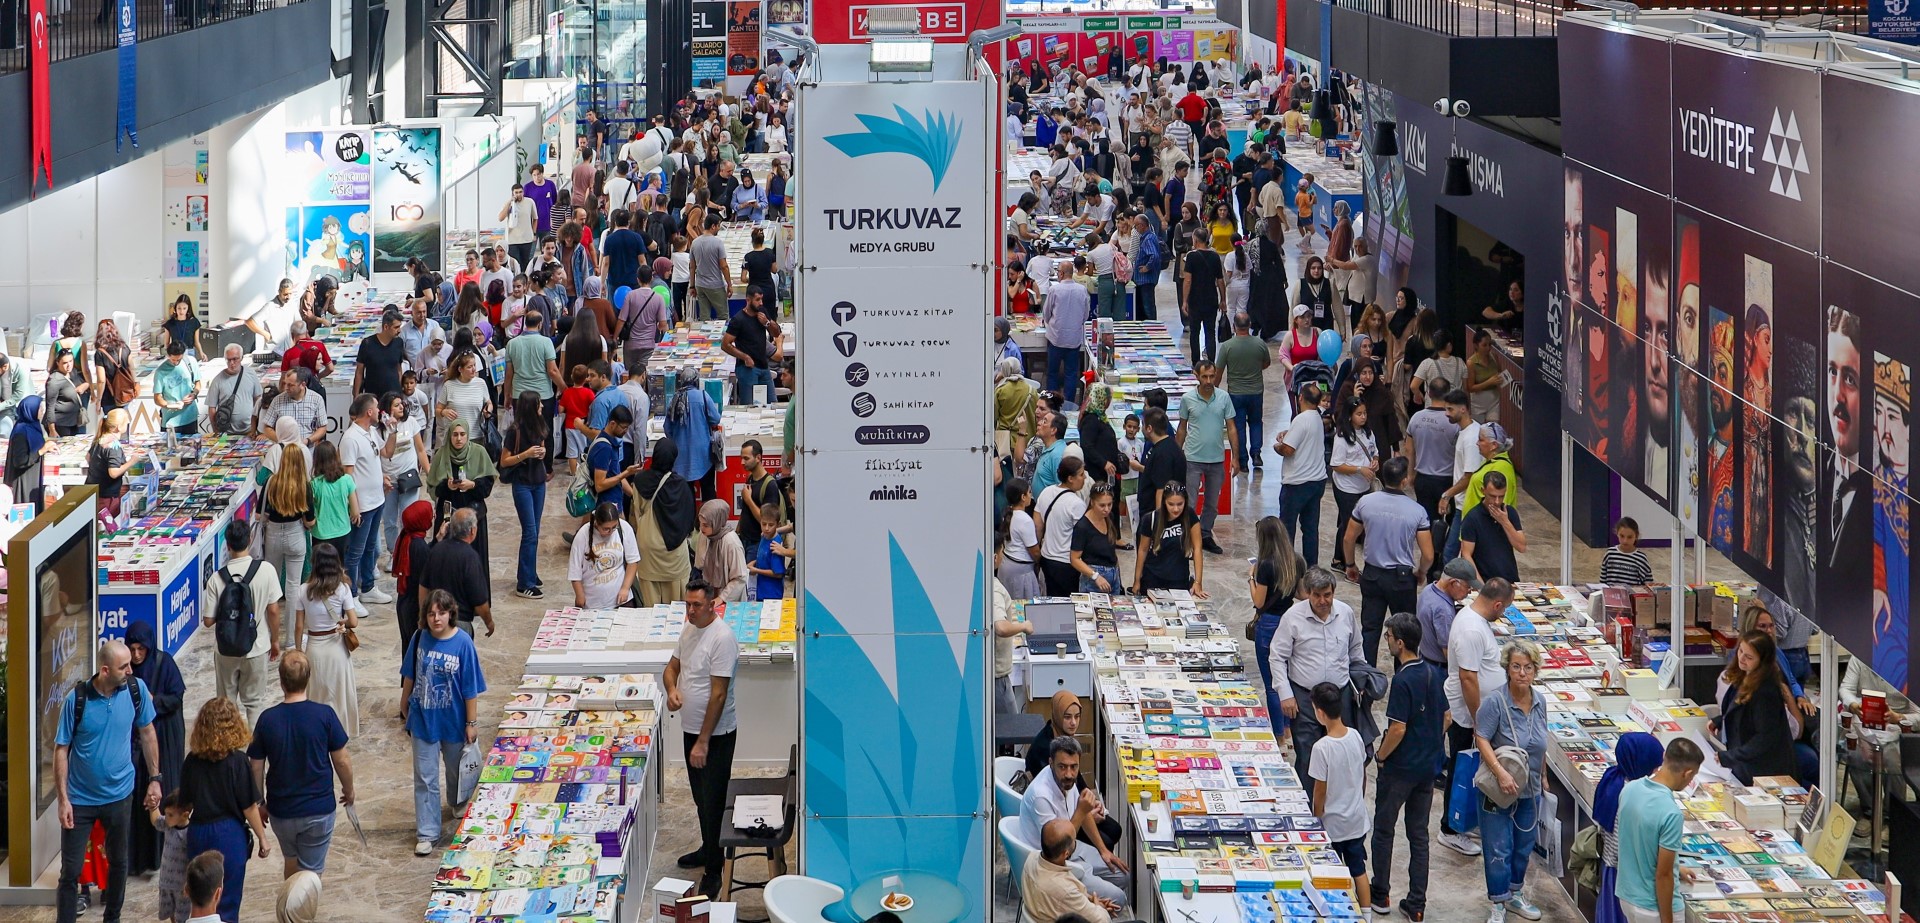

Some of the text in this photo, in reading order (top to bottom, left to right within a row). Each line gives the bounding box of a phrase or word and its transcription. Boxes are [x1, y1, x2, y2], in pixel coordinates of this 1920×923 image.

[692, 41, 723, 49] EDUARDO
[339, 136, 360, 150] KAYIP
[1679, 106, 1755, 174] YEDİTEPE
[391, 204, 424, 221] 100
[823, 207, 962, 230] TURKUVAZ
[850, 242, 935, 253] MEDYA GRUBU
[863, 309, 919, 317] TURKUVAZ
[924, 308, 954, 316] KİTAP
[1545, 342, 1563, 360] KOCAE
[883, 400, 904, 409] SAHİ
[907, 400, 935, 409] KİTAP
[897, 430, 925, 440] KİTAP
[869, 484, 918, 501] minika
[170, 577, 190, 615] Hayat
[98, 607, 128, 635] yat
[426, 650, 443, 659] NEW
[444, 661, 461, 671] CITY
